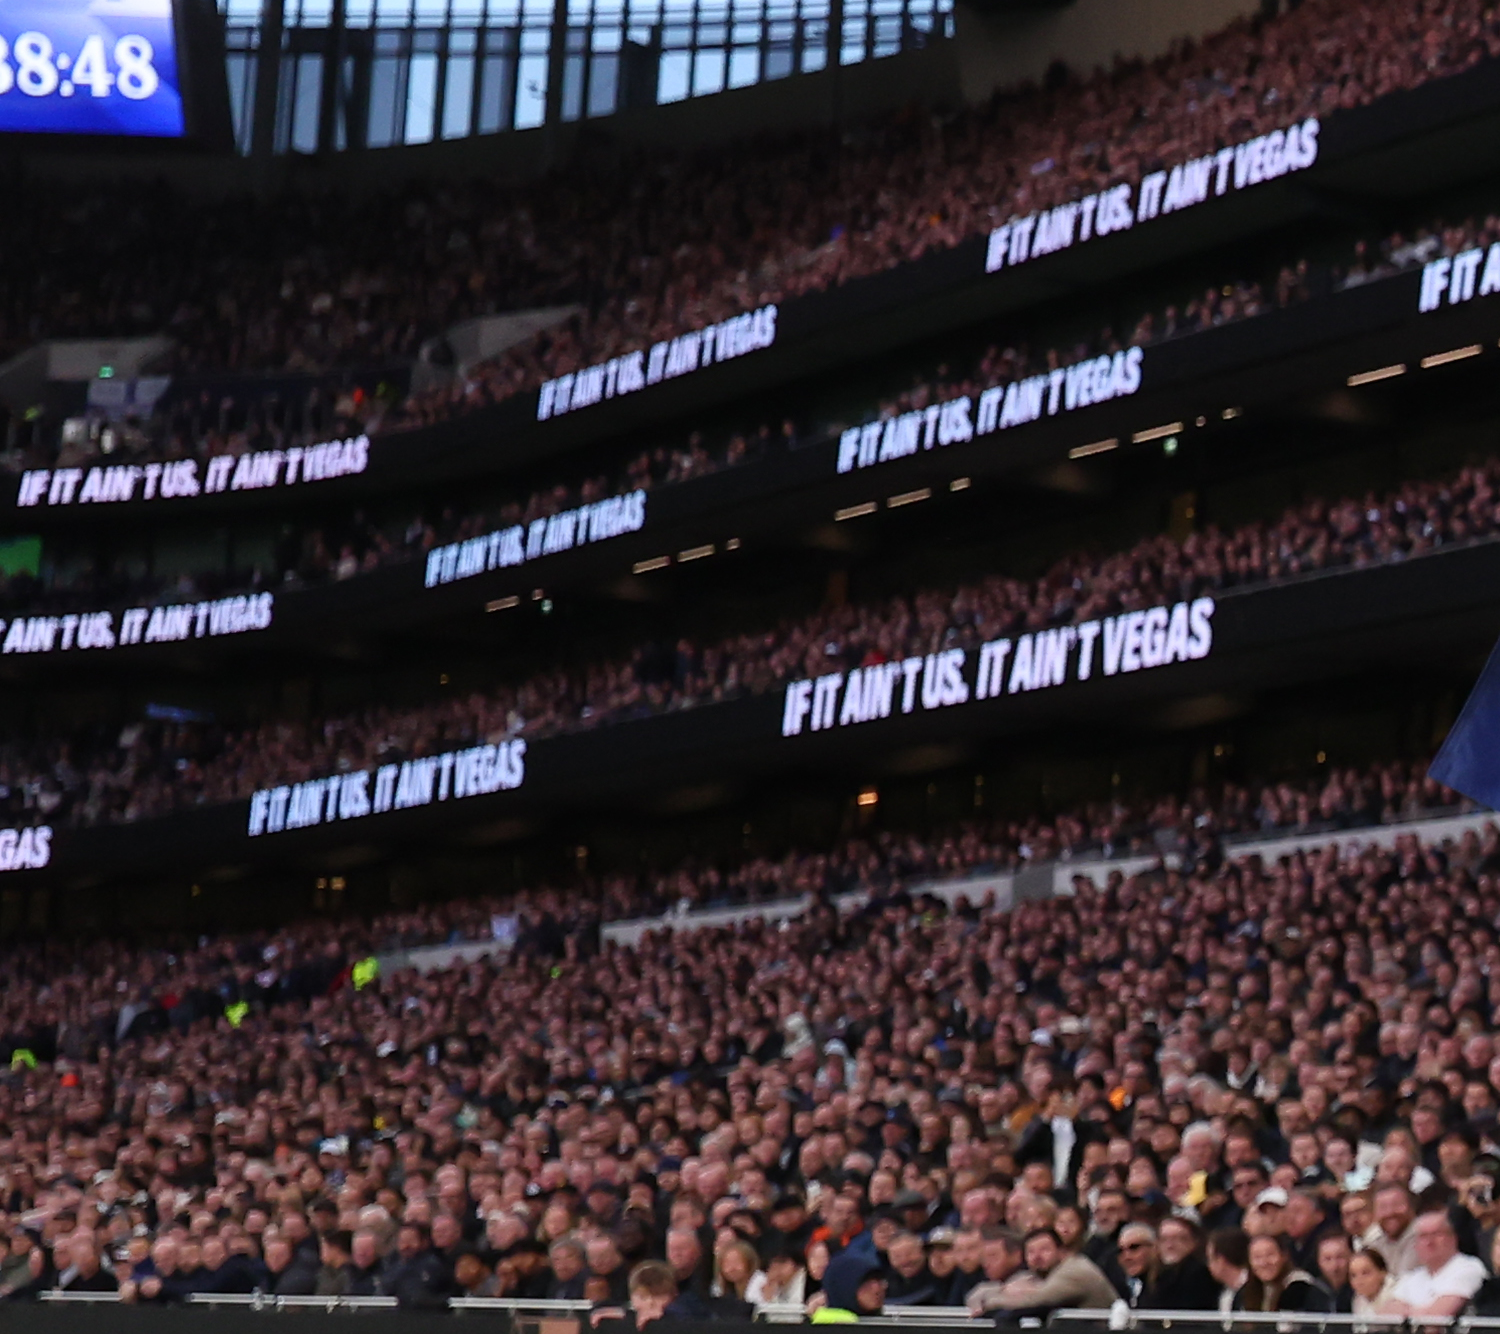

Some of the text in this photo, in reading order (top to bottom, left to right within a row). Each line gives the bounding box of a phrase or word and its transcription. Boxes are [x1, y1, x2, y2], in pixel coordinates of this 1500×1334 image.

[1418, 261, 1449, 313] IF
[1448, 247, 1483, 304] IT
[782, 681, 812, 737] IF
[811, 672, 842, 731] IT
[840, 656, 922, 725] AIN'T
[976, 638, 1010, 700] IT
[1009, 619, 1099, 694] AIN'T
[1102, 597, 1214, 676] VEGAS
[0, 825, 54, 871] GAS
